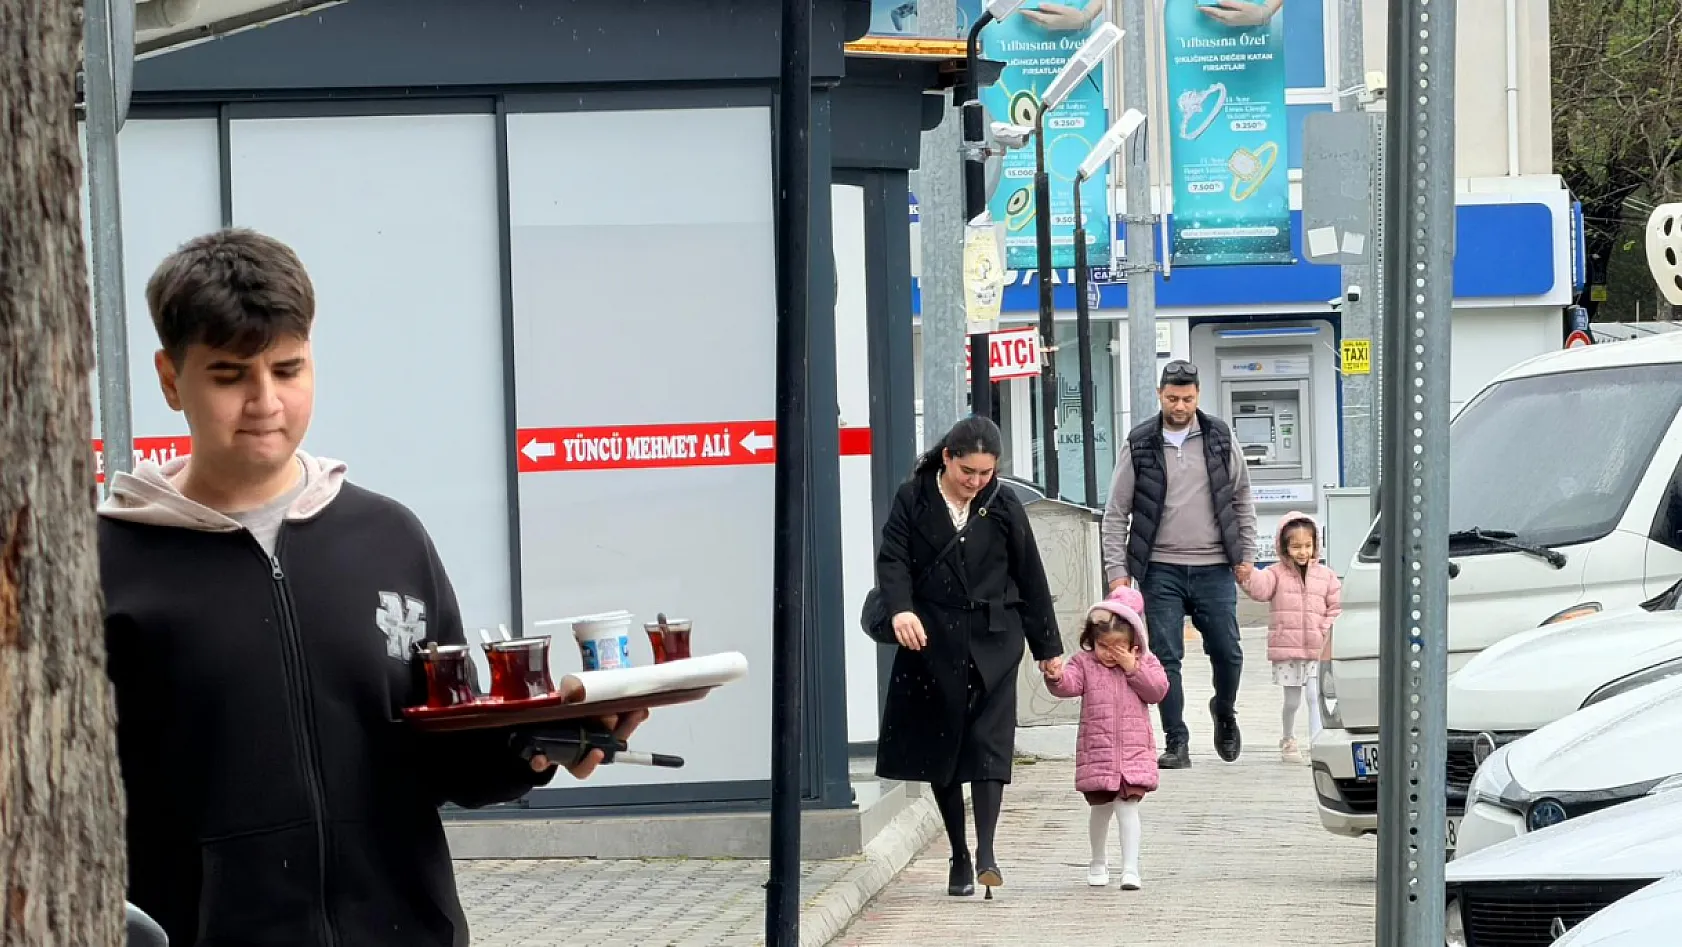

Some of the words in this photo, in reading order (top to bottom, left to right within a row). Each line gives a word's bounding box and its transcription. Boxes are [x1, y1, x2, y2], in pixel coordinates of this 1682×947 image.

[1343, 347, 1369, 361] TAXI
[562, 432, 623, 462] YÜNCÜ
[626, 434, 698, 460] MEHMET
[701, 428, 732, 458] ALİ
